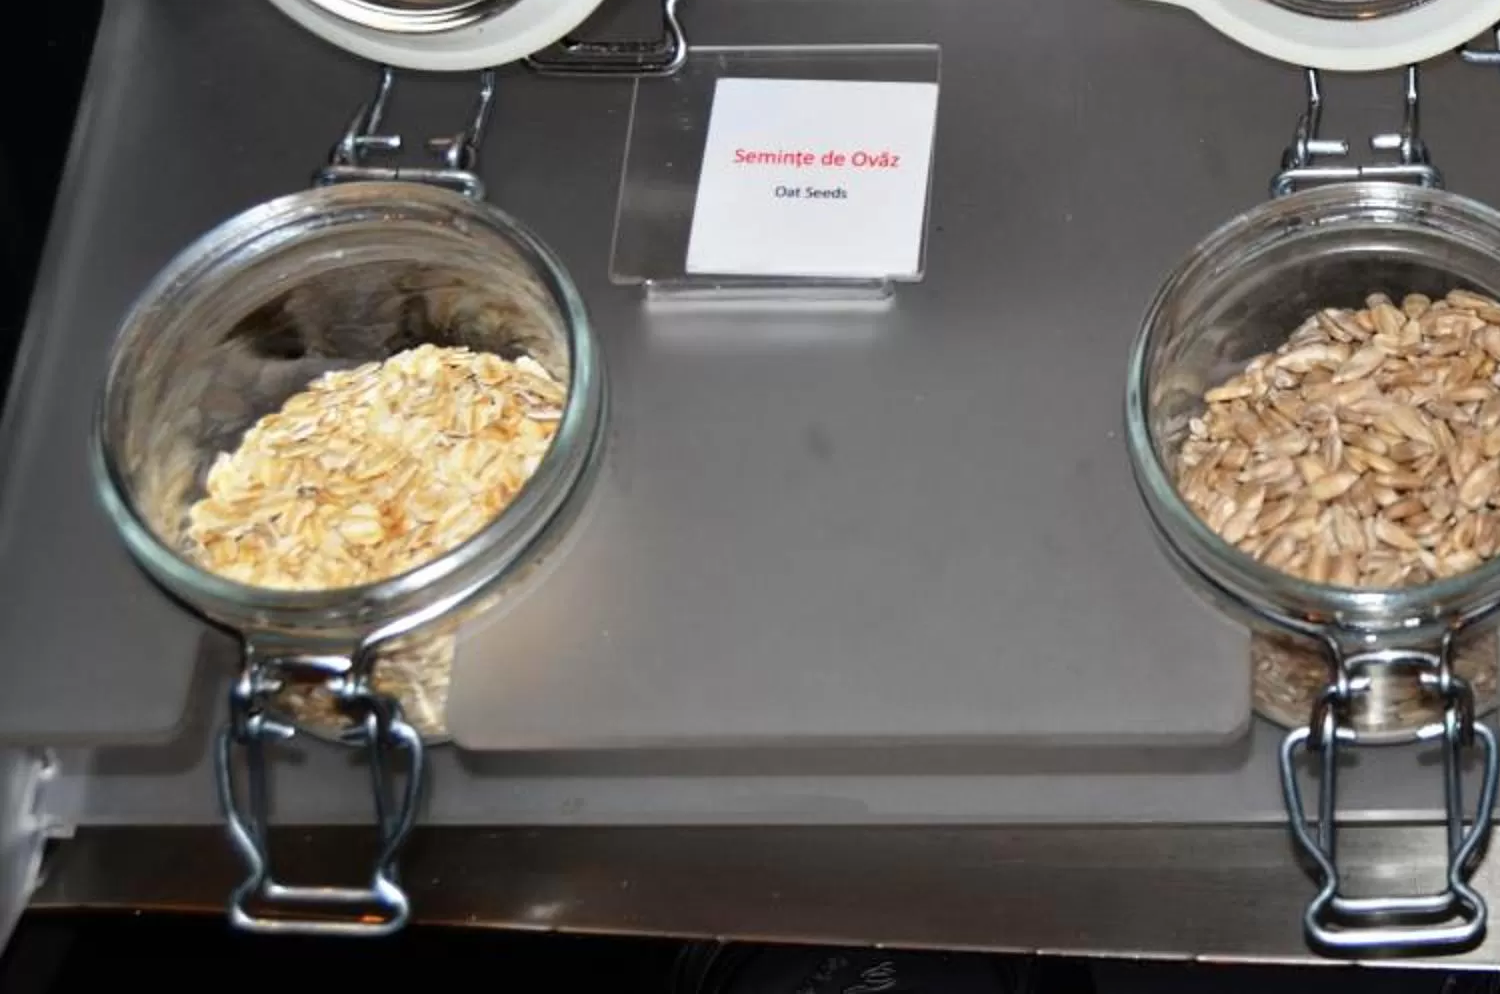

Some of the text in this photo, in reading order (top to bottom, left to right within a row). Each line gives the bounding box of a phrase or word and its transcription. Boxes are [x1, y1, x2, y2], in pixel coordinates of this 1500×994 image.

[821, 151, 846, 166] de
[775, 185, 847, 199] Oat Seeds
